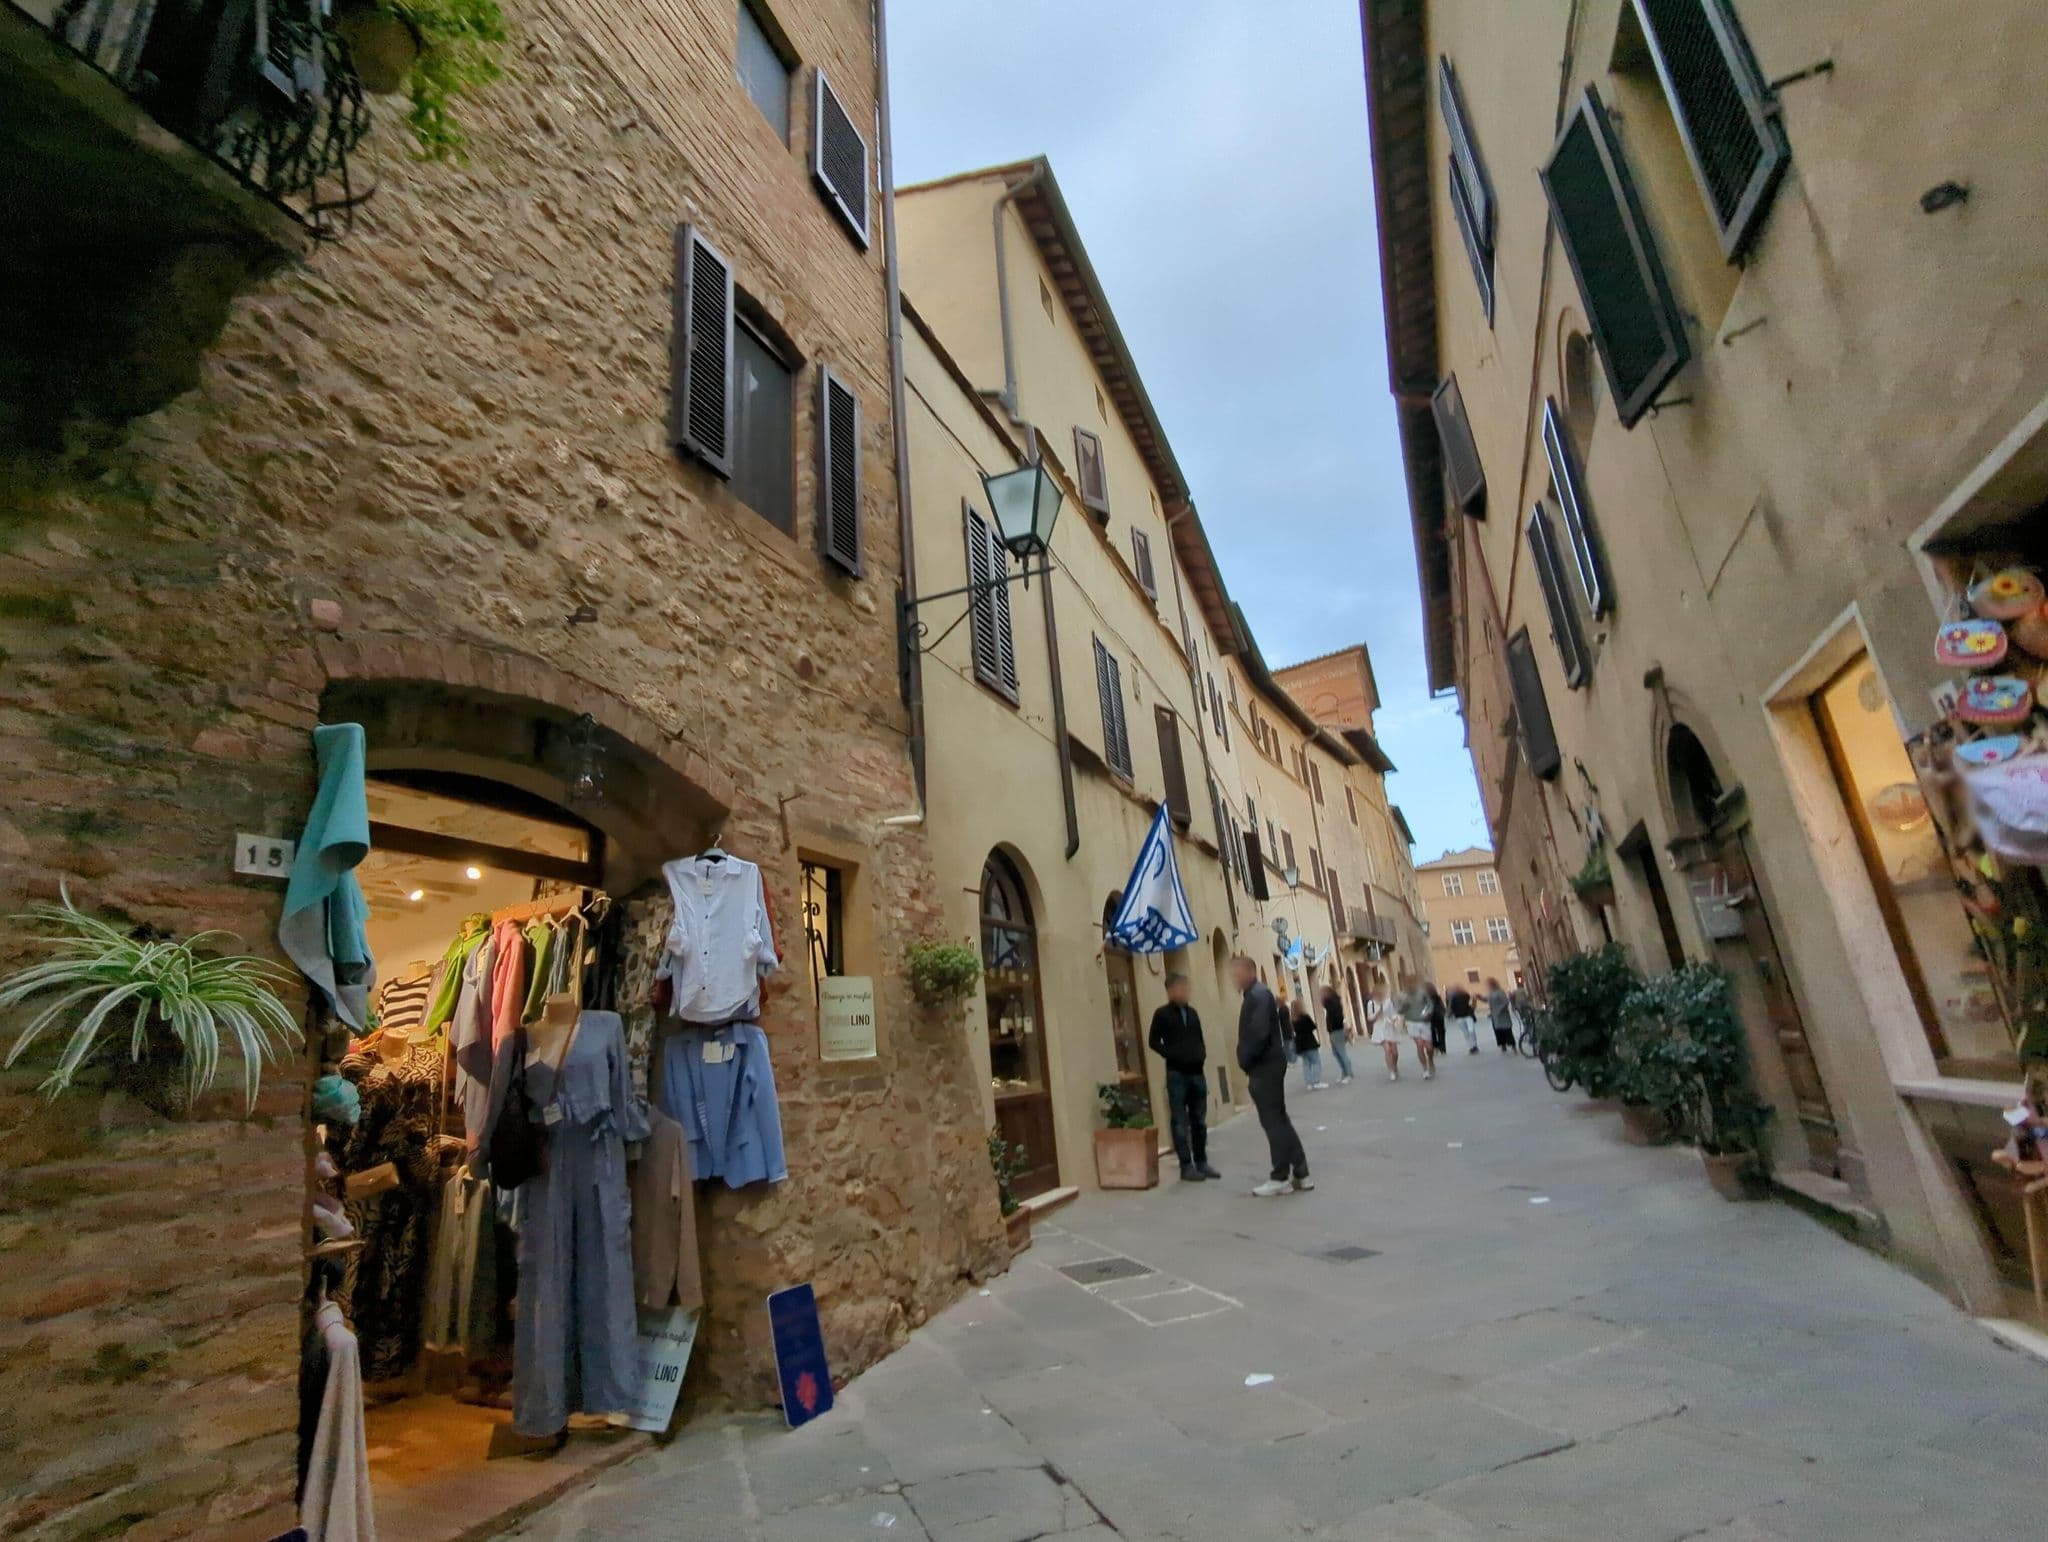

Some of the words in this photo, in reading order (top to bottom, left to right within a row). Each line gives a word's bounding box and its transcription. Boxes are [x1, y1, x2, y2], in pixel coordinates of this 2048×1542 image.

[248, 845, 283, 868] 15
[850, 1014, 870, 1027] LINO
[655, 1362, 679, 1383] LINO
